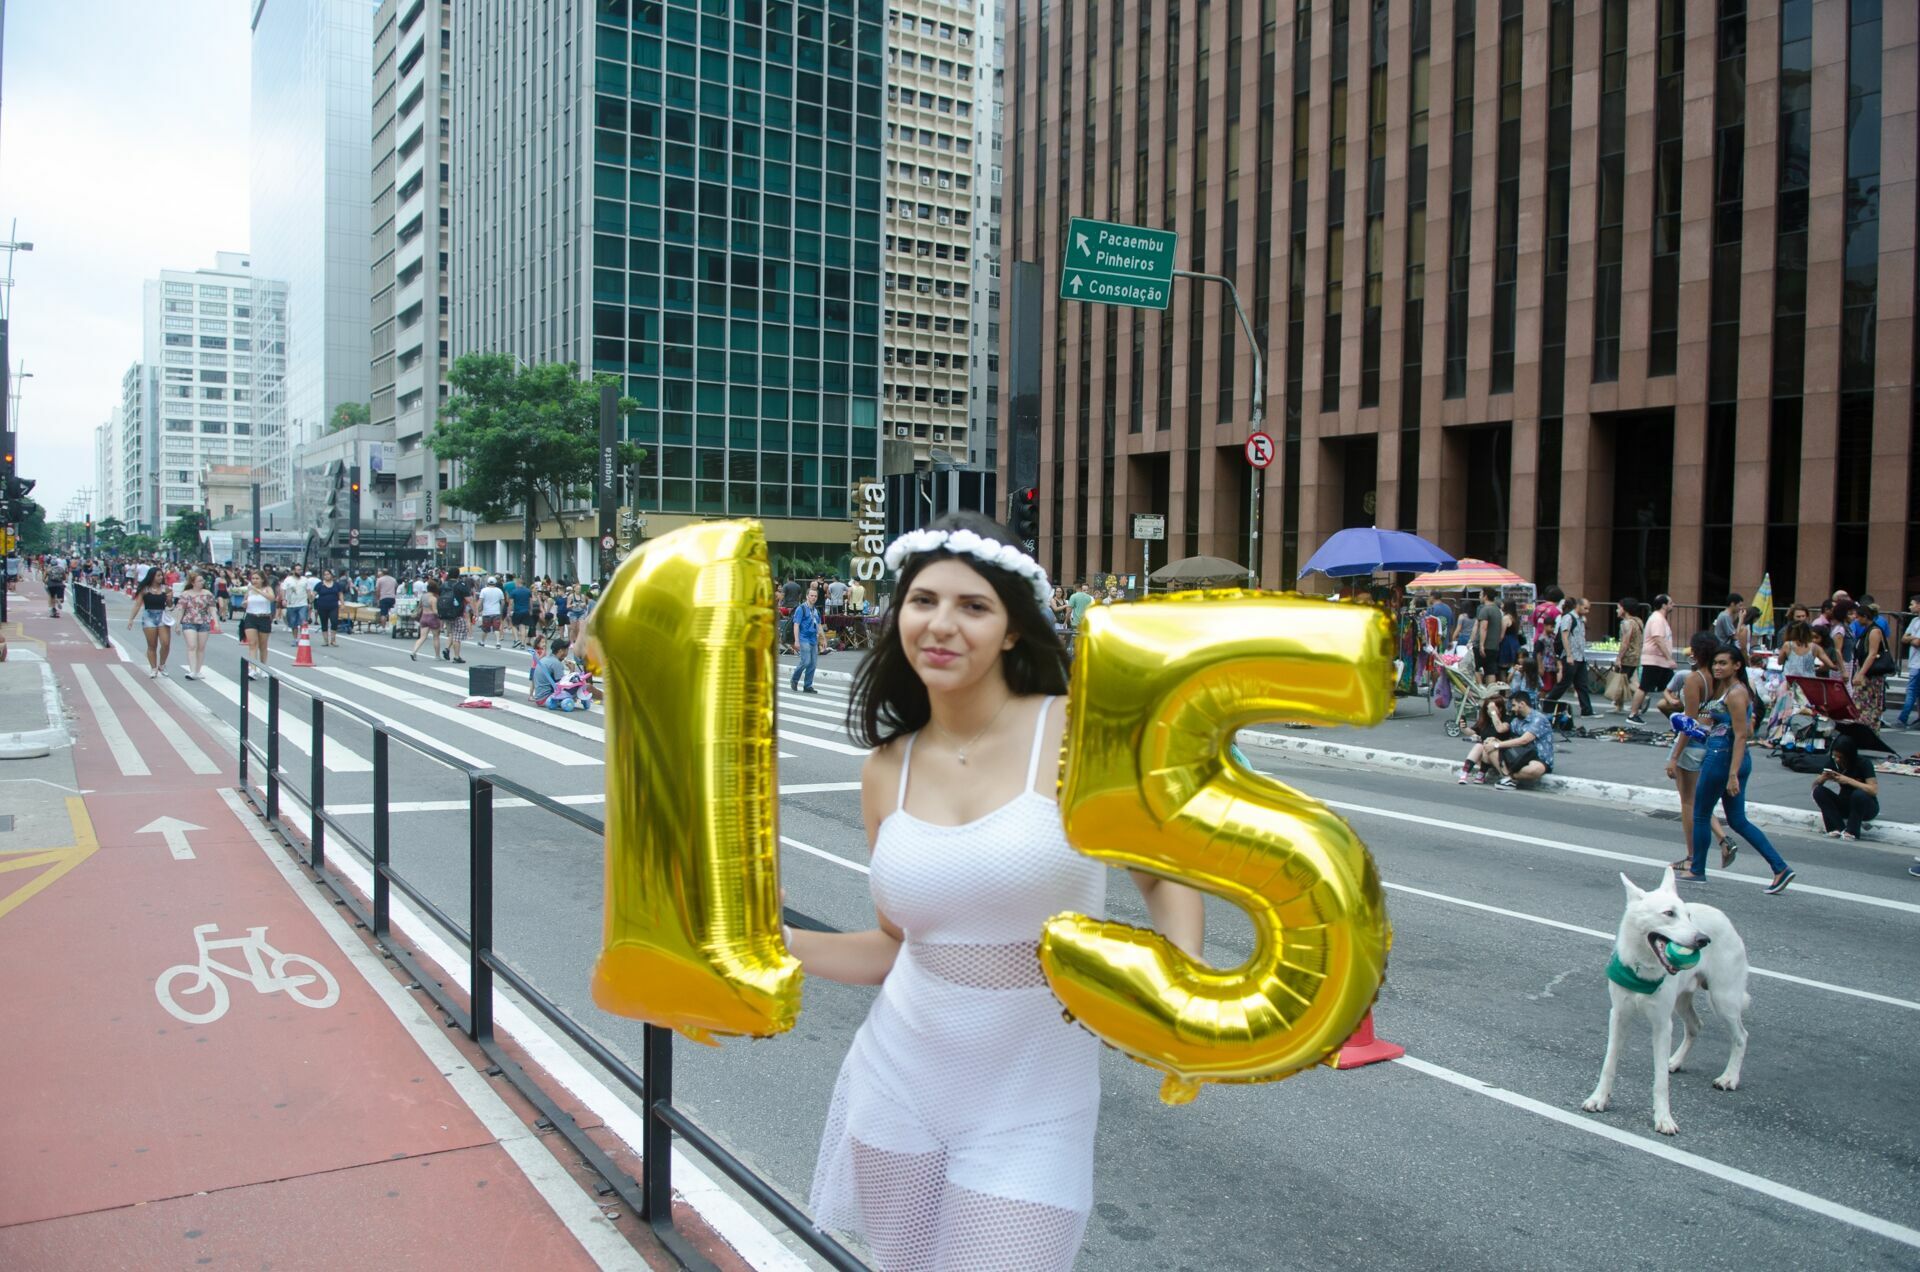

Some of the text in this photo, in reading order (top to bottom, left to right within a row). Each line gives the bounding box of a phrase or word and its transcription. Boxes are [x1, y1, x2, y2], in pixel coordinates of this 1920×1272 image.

[1099, 230, 1164, 252] Pacaembu
[1096, 250, 1154, 271] Pinheiros
[1089, 279, 1162, 302] Consolação
[603, 447, 612, 489] Augusta
[857, 482, 886, 581] Safra
